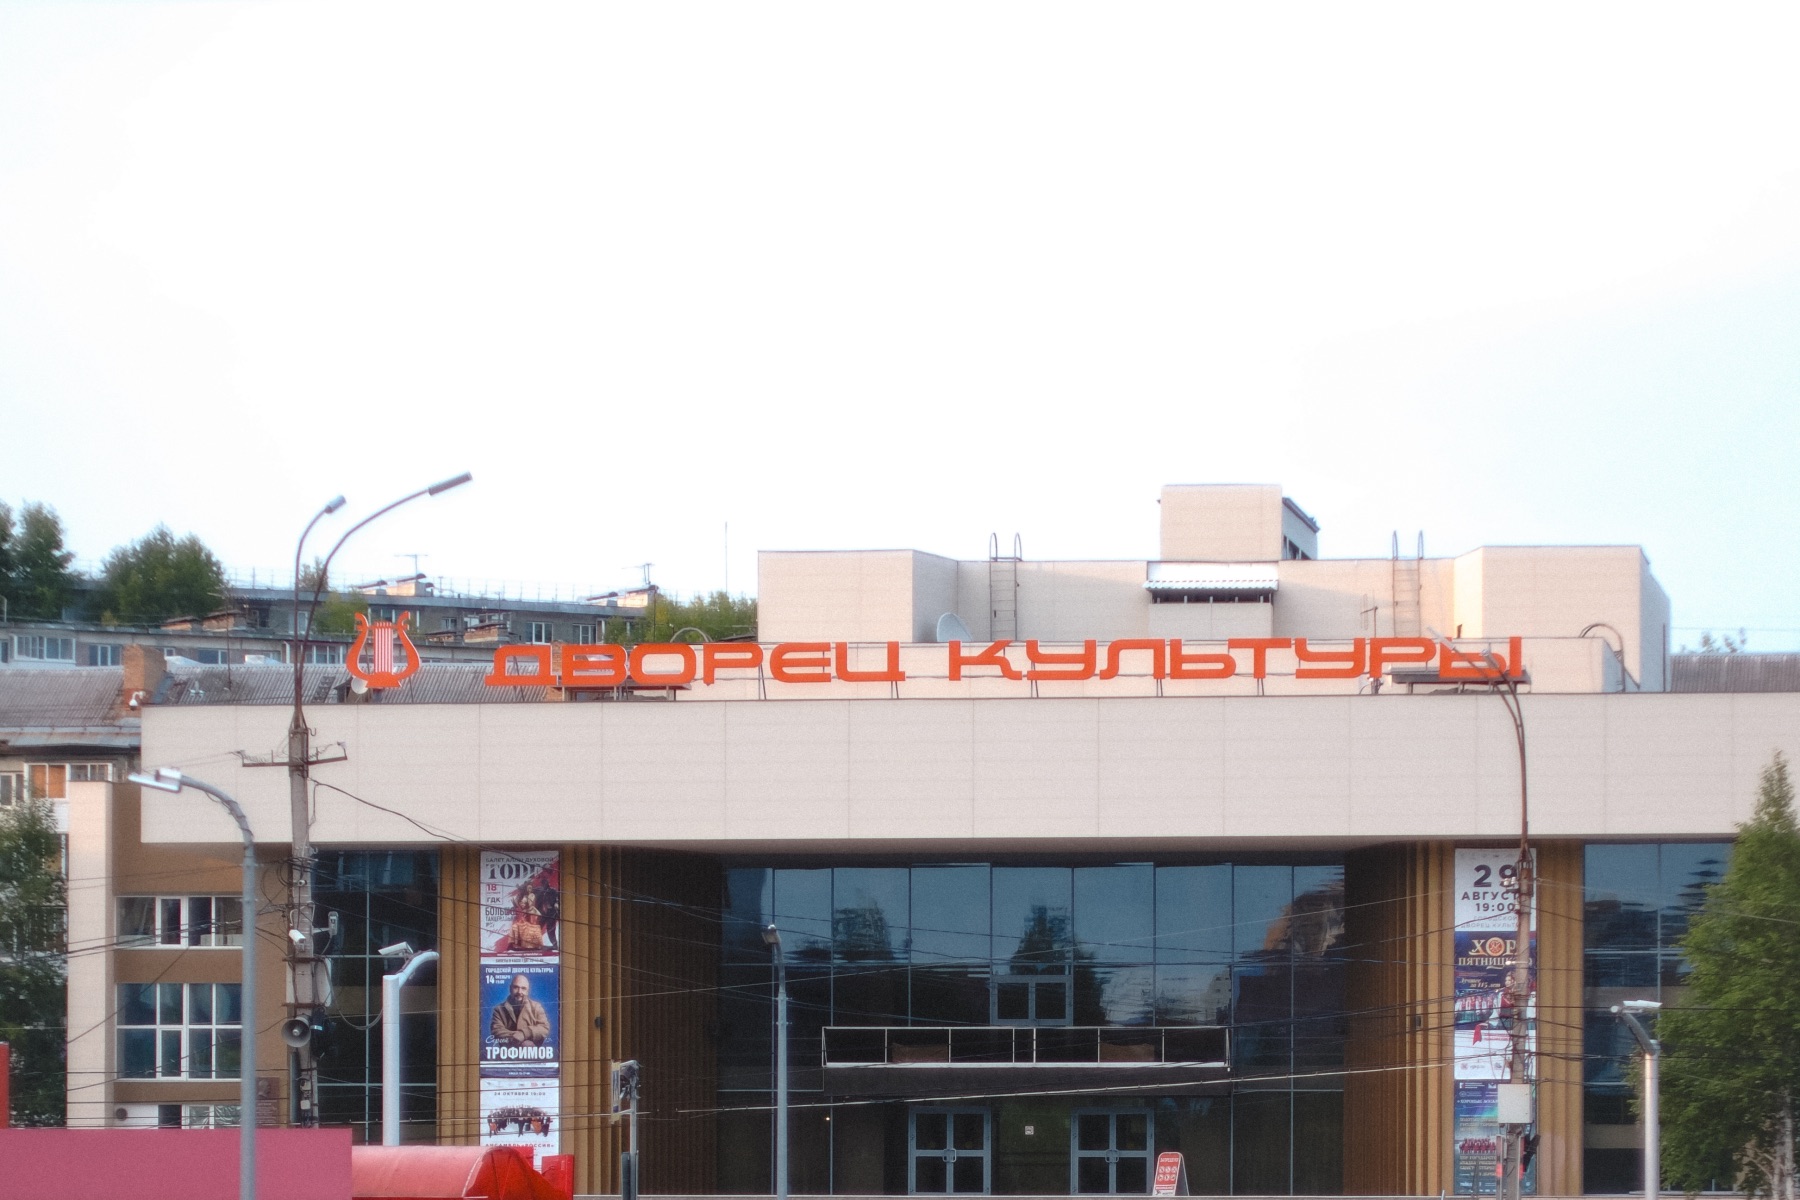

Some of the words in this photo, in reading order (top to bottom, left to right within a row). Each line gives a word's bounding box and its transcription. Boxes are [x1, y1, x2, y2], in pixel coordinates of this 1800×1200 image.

[485, 641, 906, 687] ДВОРЕЦ
[948, 636, 1522, 681] КУЛЬТУРЫ
[1474, 865, 1517, 888] 29
[486, 883, 497, 891] 18
[1462, 891, 1518, 900] АВГУСТ
[1475, 903, 1516, 912] 19:00
[486, 975, 495, 984] 14
[486, 1047, 553, 1059] ТРОФИМОВ
